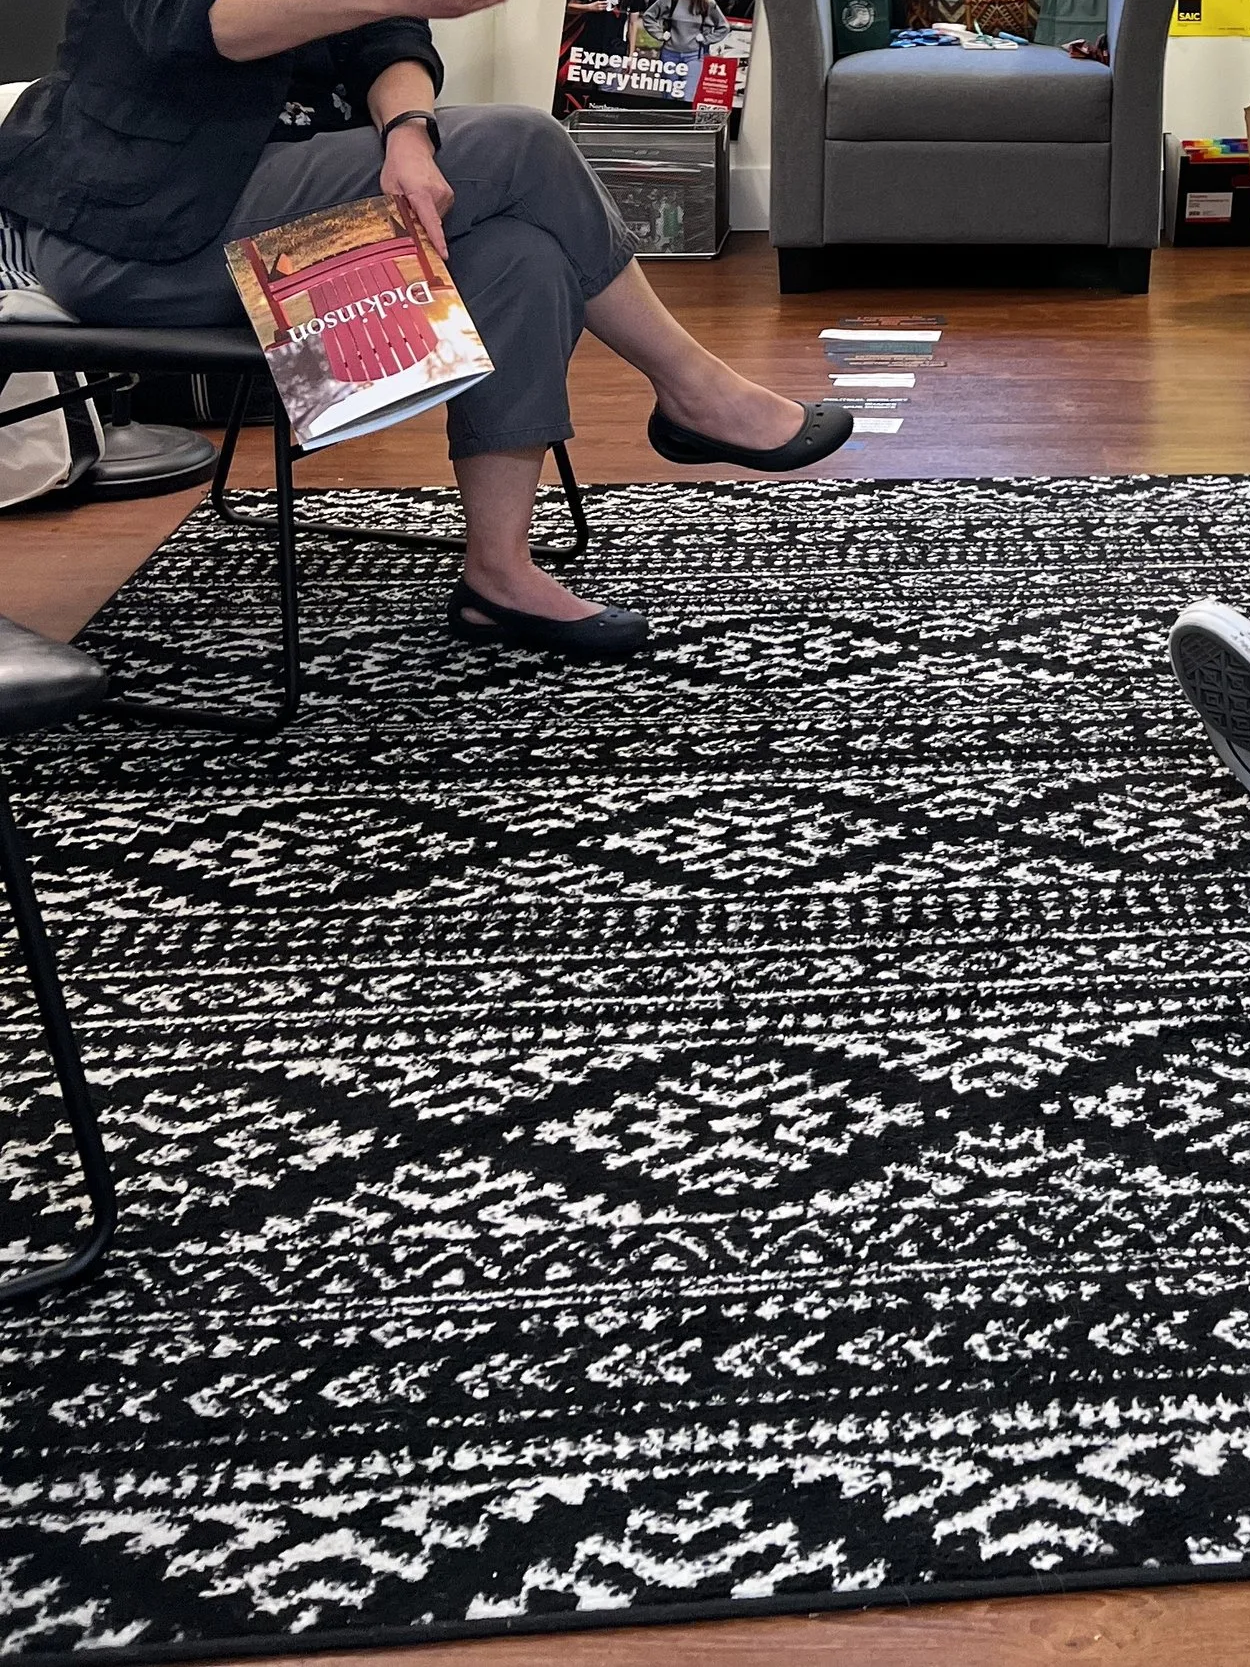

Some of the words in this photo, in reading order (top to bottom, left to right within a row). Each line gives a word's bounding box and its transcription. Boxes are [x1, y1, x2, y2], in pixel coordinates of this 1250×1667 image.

[1179, 12, 1201, 21] SAIC
[569, 46, 689, 77] Experience
[708, 62, 727, 77] #1
[567, 64, 687, 98] Everything
[287, 280, 436, 344] Dickinson
